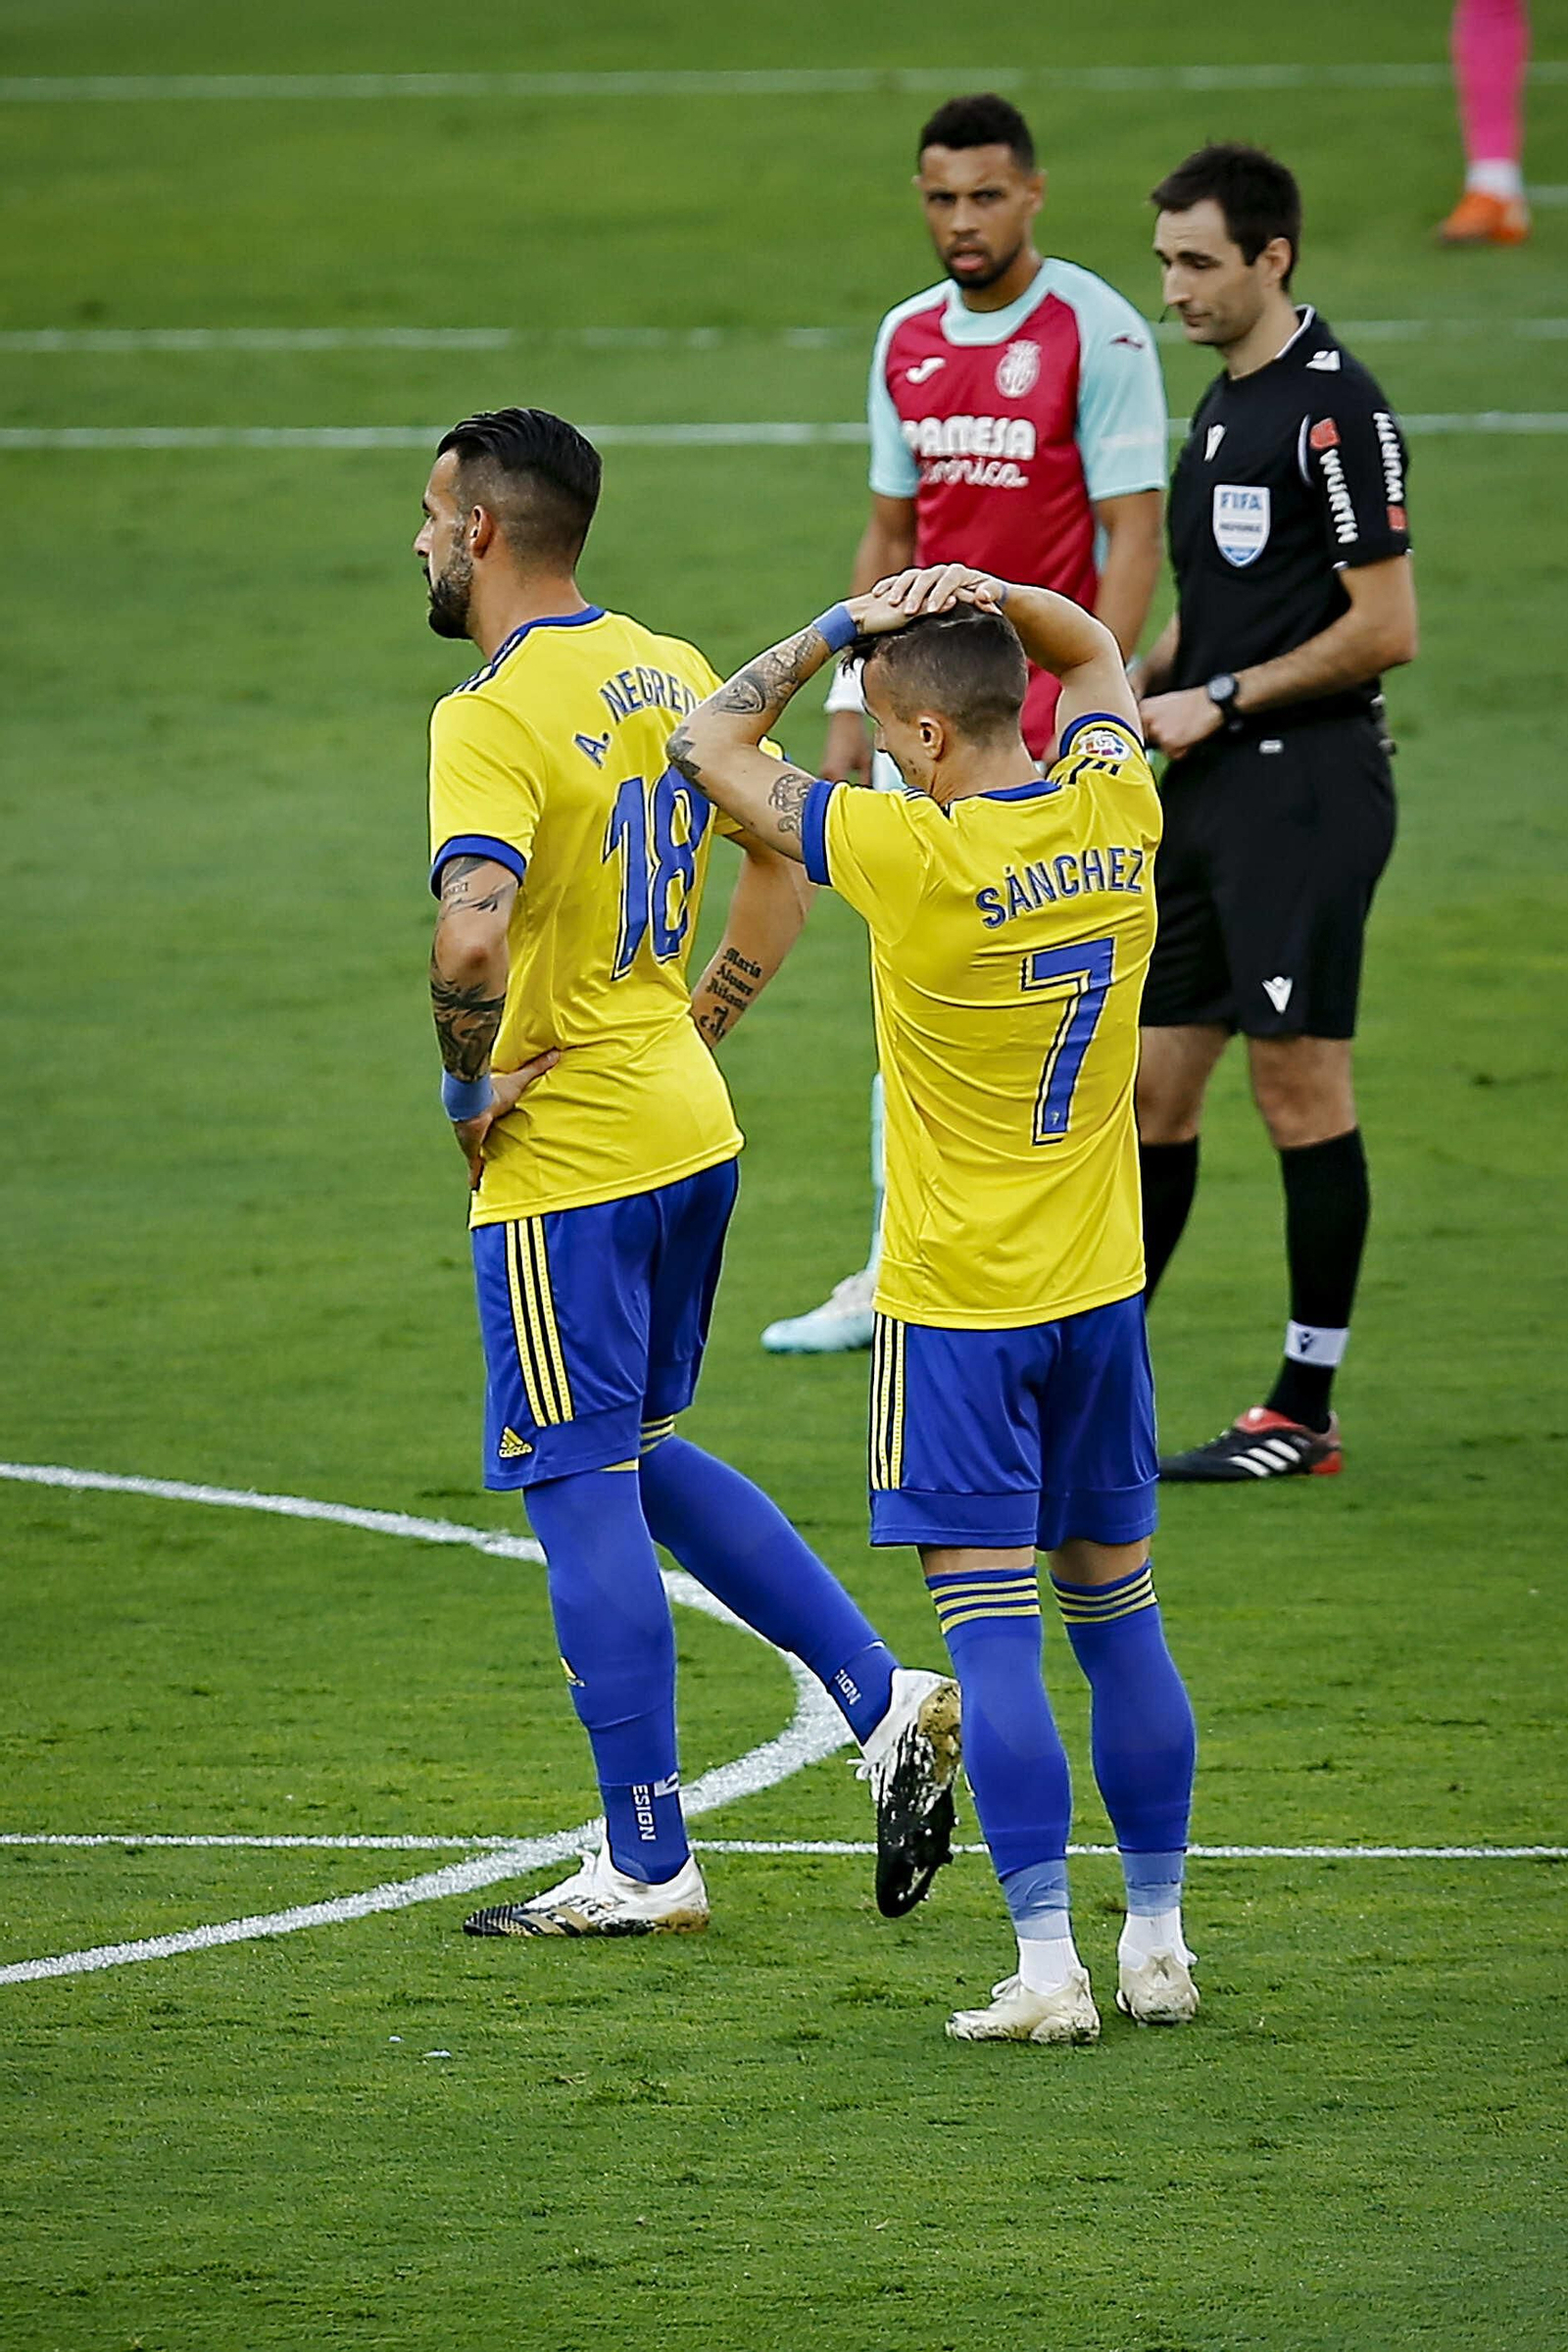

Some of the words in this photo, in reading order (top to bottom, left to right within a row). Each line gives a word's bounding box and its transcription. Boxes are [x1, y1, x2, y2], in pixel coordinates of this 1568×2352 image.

[1220, 491, 1262, 510] FIFA
[573, 732, 609, 770] A.
[599, 665, 703, 724] NEGRED
[602, 763, 715, 982] 18
[976, 848, 1144, 930] SÁNCHEZ
[1019, 936, 1116, 1147] 7
